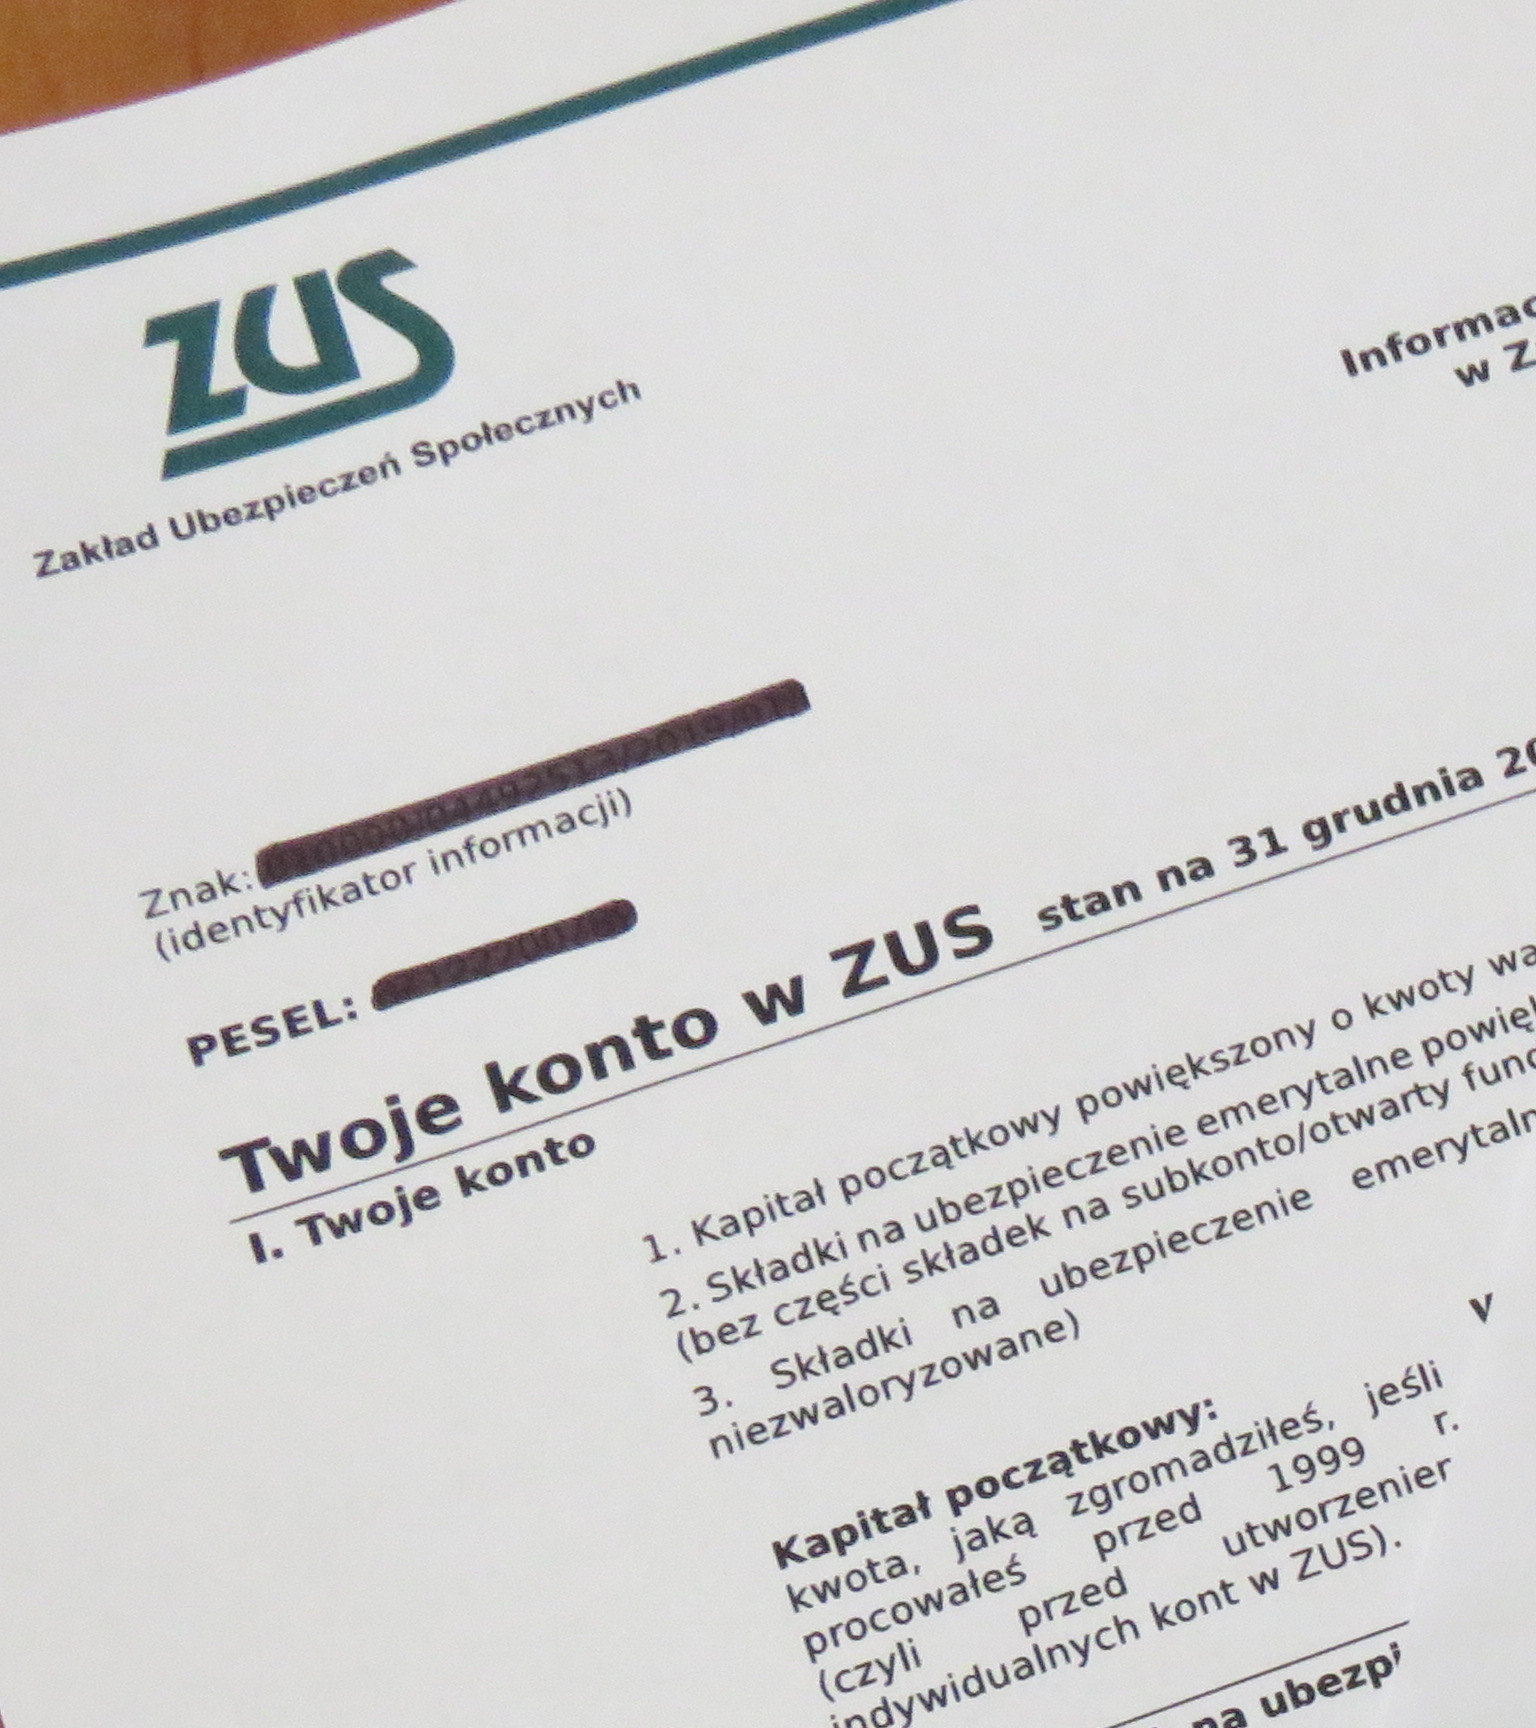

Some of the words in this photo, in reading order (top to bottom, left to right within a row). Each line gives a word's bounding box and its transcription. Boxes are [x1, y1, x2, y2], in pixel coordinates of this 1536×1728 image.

[142, 247, 455, 480] ZUS
[1455, 360, 1489, 387] w
[34, 523, 159, 578] Zakład
[169, 453, 401, 540] Ubezpieczeń
[411, 380, 640, 467] Społecznych
[140, 871, 251, 919] Znak:
[157, 862, 415, 961] (identyfikator
[430, 788, 631, 874] informacji)
[187, 998, 357, 1067] PESEL:
[219, 1094, 462, 1193] Twoje
[485, 1008, 718, 1113] konto
[742, 975, 804, 1026] w
[830, 905, 993, 998] ZUS
[1038, 881, 1142, 931] stan
[1157, 857, 1215, 892] na
[1228, 827, 1288, 867] 31
[1302, 767, 1484, 851] grudnia
[249, 1233, 283, 1264] I.
[295, 1186, 441, 1246] Twoje
[455, 1134, 595, 1197] konto
[644, 1235, 680, 1263] 1.
[691, 1178, 825, 1246] Kapitał
[839, 1105, 1060, 1205] początkowy
[1076, 1019, 1315, 1124] powiększony
[1332, 1009, 1353, 1030] o
[1363, 965, 1473, 1019] kwoty
